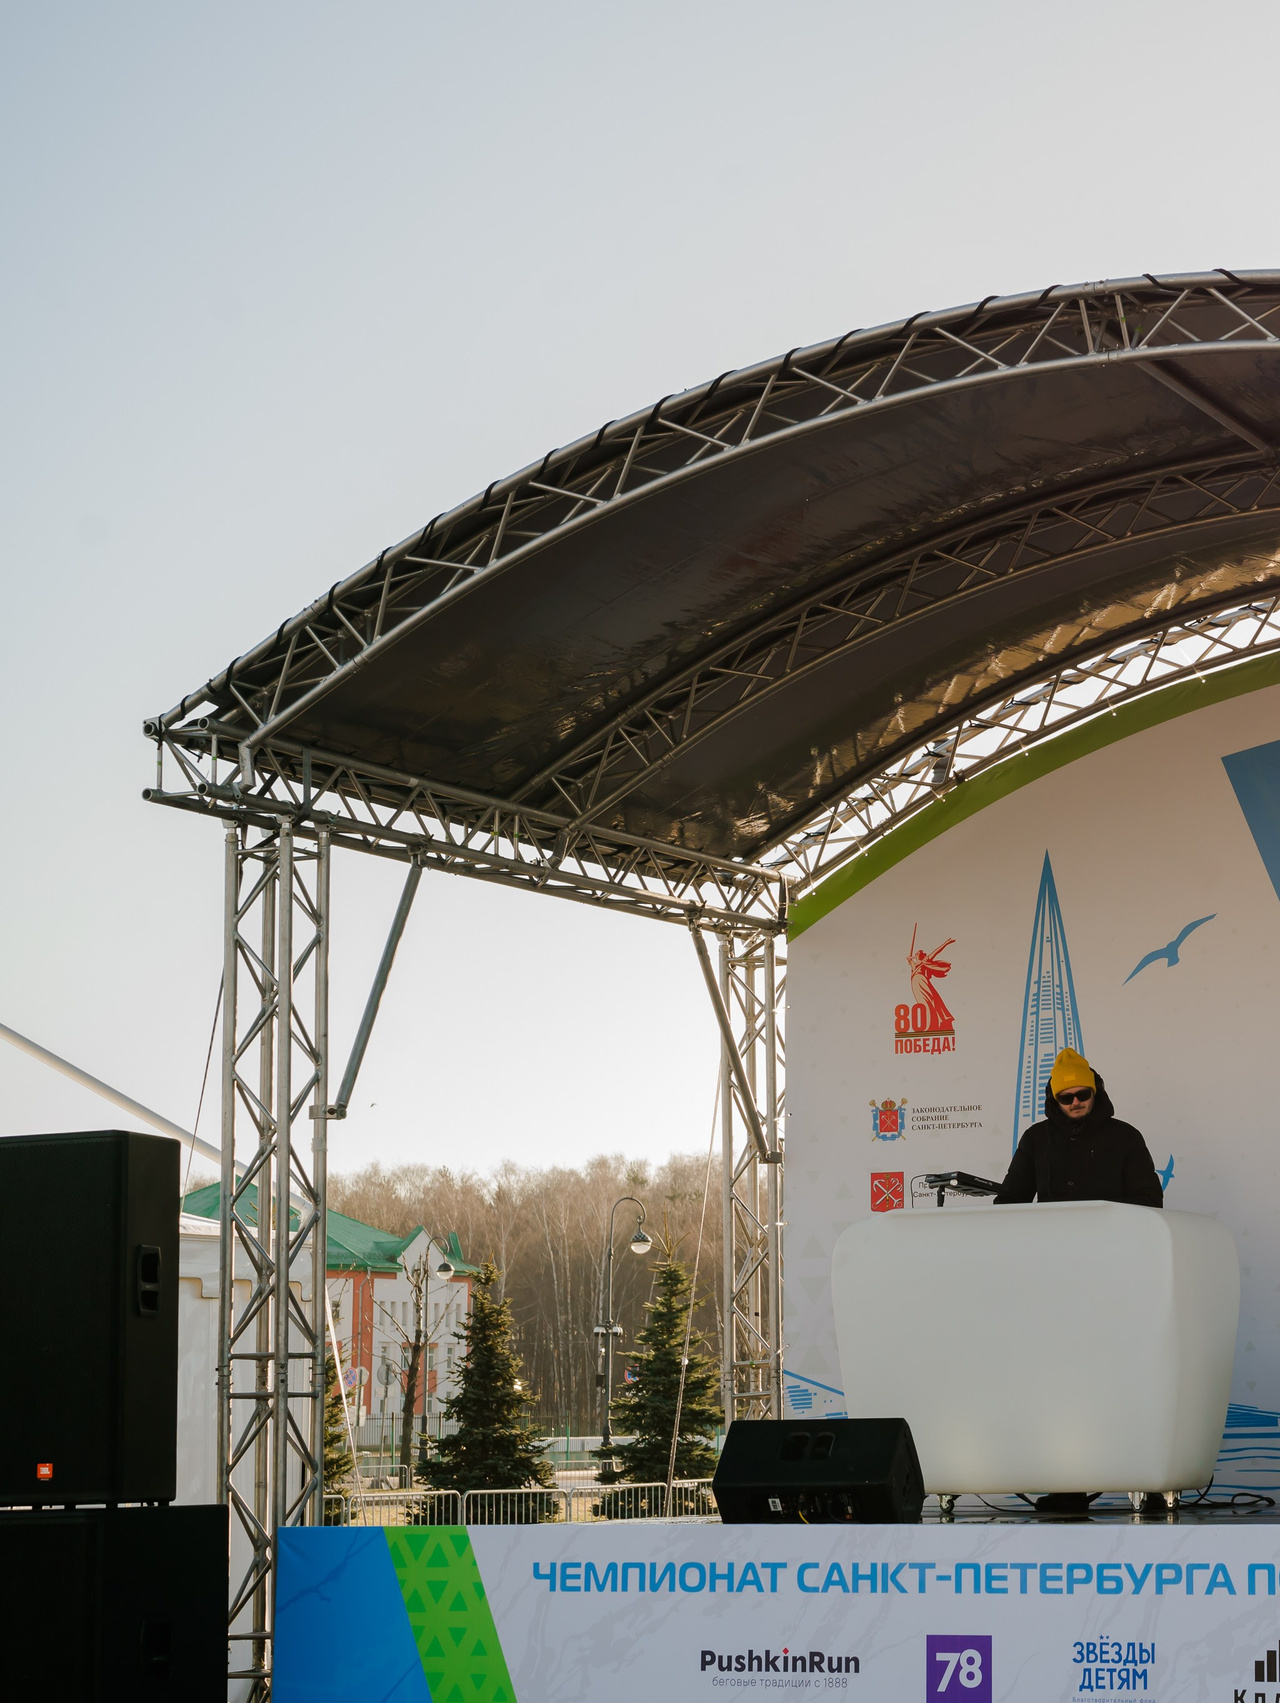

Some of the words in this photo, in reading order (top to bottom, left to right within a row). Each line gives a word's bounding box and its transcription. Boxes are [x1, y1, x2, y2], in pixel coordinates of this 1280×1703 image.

[894, 1003, 927, 1033] 80
[894, 1036, 956, 1055] ПОБЕДА!
[911, 1104, 983, 1114] ЗАКОНОДАТЕЛЬНОЕ
[911, 1114, 950, 1123] СОБРАНИЕ
[911, 1121, 983, 1131] САНКТ-ПЕТЕРБУРГА
[532, 1561, 787, 1593] ЧЕМПИОНАТ
[796, 1561, 1236, 1596] САНКТ-ПЕТЕРБУРГА
[700, 1647, 860, 1674] PushkinRun
[1072, 1635, 1156, 1666] ЗВЁЗДЫ
[936, 1648, 983, 1692] 78
[1079, 1668, 1148, 1692] ДЕТЯМ
[712, 1676, 757, 1687] беговые
[760, 1677, 811, 1689] традиции
[814, 1679, 821, 1687] с
[823, 1677, 848, 1688] 1888
